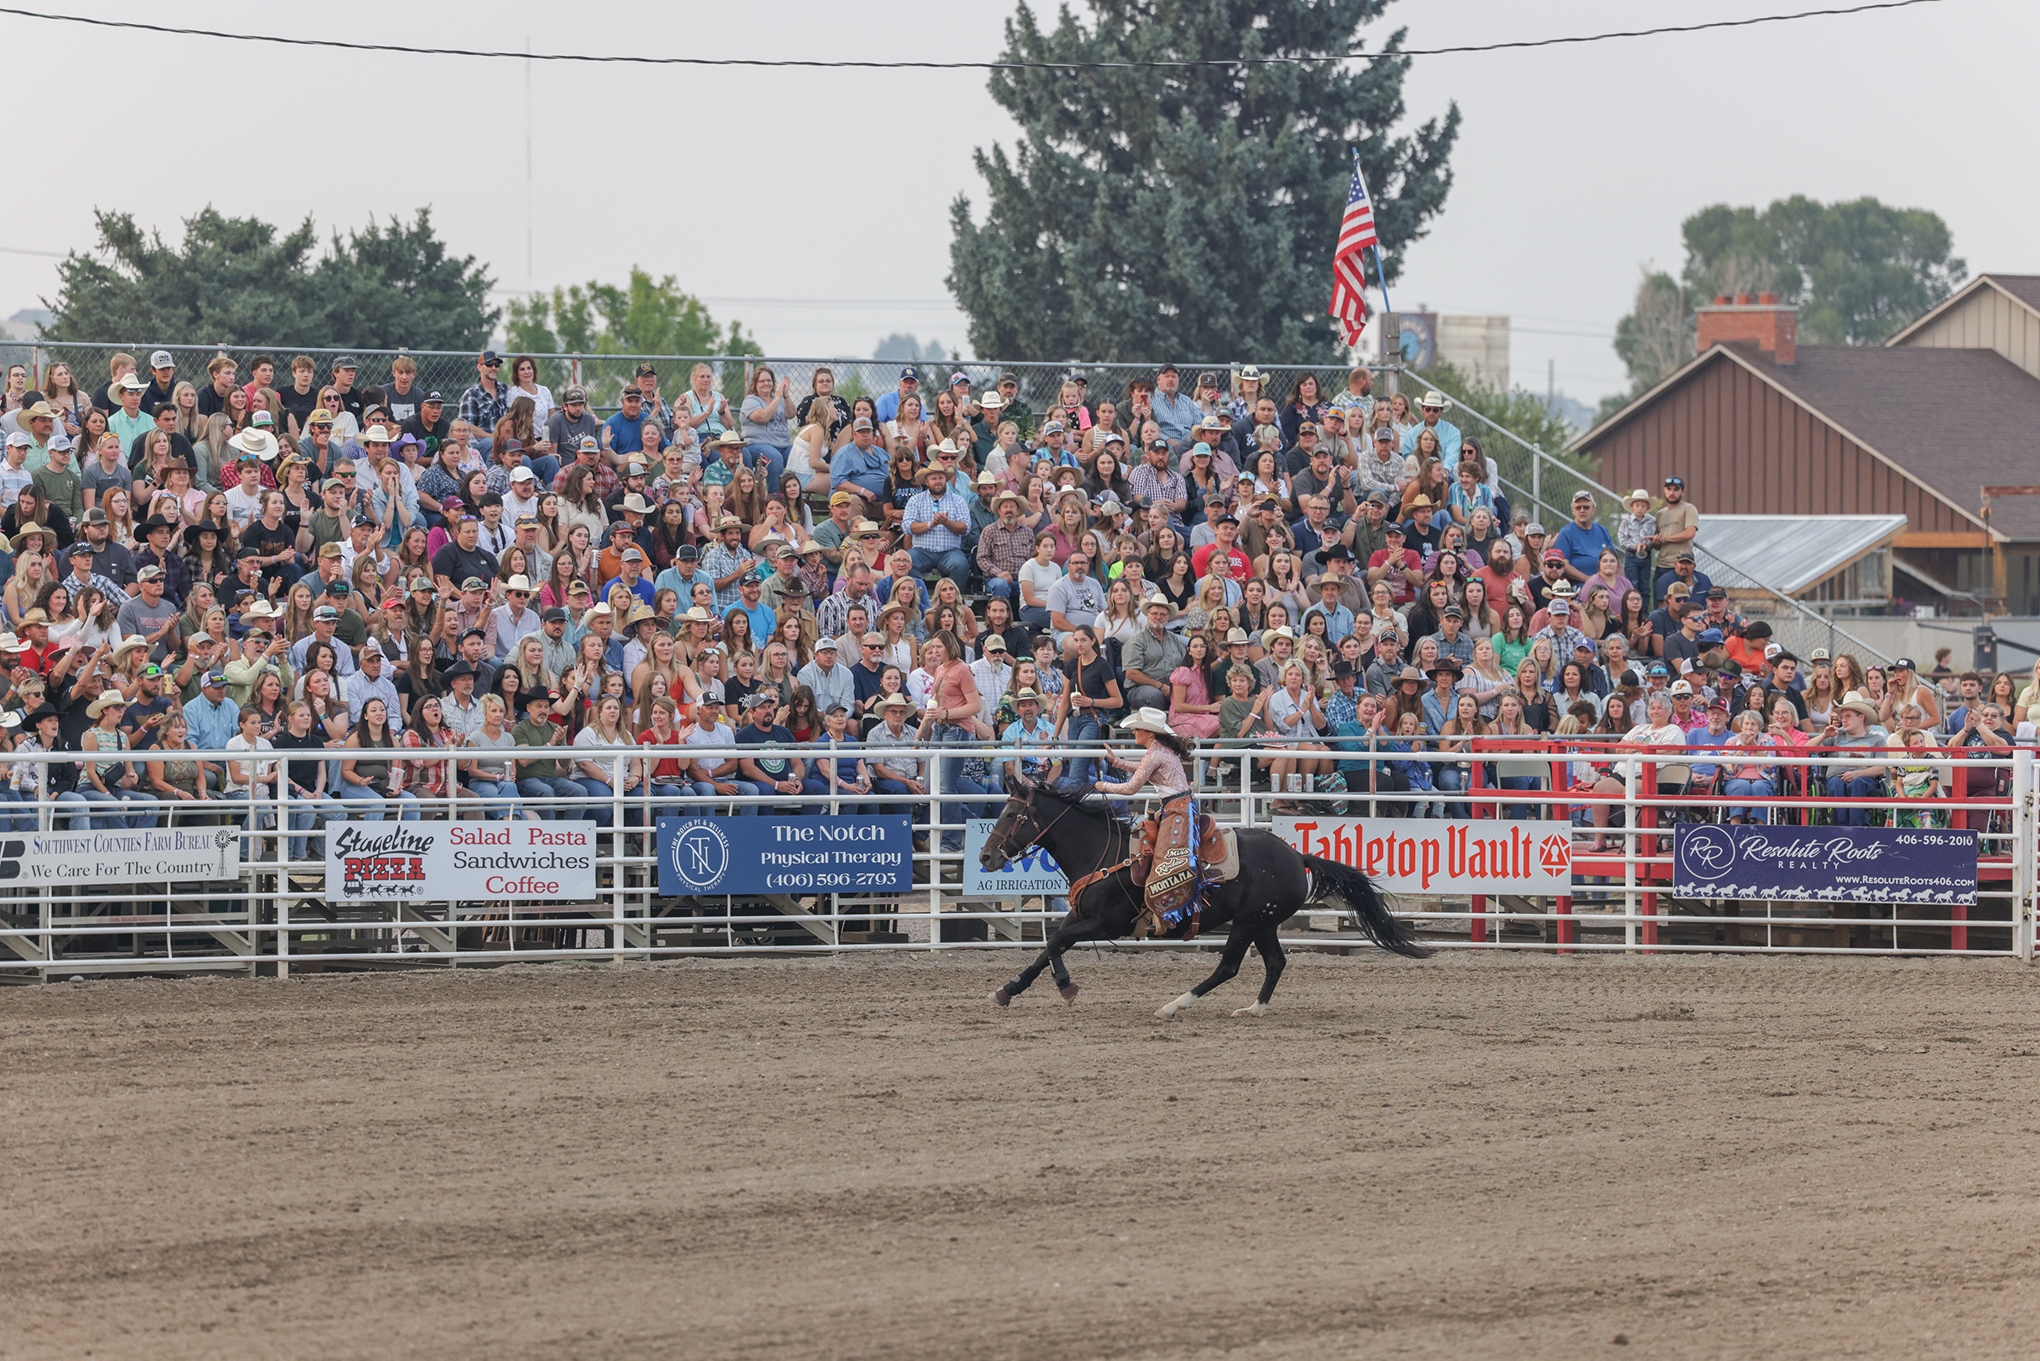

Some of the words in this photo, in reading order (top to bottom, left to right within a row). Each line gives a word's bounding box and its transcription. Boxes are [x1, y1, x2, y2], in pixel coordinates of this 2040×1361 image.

[450, 827, 512, 846] Salad
[528, 827, 588, 846] Pasta
[670, 837, 679, 850] THE
[676, 821, 693, 837] NOTCH
[709, 821, 730, 848] WELLNESS
[771, 825, 814, 842] The
[819, 824, 885, 842] Notch
[978, 823, 995, 834] YO
[145, 831, 172, 852] FARM
[175, 830, 213, 851] BUREAU
[334, 824, 435, 860] Stageline
[1739, 835, 1824, 862] Resolute
[1824, 836, 1888, 863] Roots
[1894, 834, 1974, 847] 406-596-2010
[453, 850, 590, 869] Sandwiches
[761, 851, 829, 868] Physical
[832, 851, 902, 867] Therapy
[1167, 848, 1191, 859] Miss
[1294, 821, 1440, 891] Tabletop
[1447, 824, 1533, 880] Vault
[31, 864, 52, 879] We
[56, 863, 91, 878] Care
[95, 862, 120, 877] For
[124, 861, 151, 876] The
[156, 860, 214, 877] Country
[344, 857, 426, 881] PIZZA
[1158, 858, 1187, 874] Rodeo
[1778, 861, 1840, 870] REALTY
[486, 875, 560, 895] Coffee
[676, 873, 702, 893] PHYSICAL
[703, 872, 726, 892] THERAPY
[766, 872, 814, 889] (406)
[816, 871, 897, 887] 596-2793
[977, 879, 993, 891] AG
[995, 879, 1063, 891] IRRIGATION
[1149, 869, 1194, 895] MONTANA
